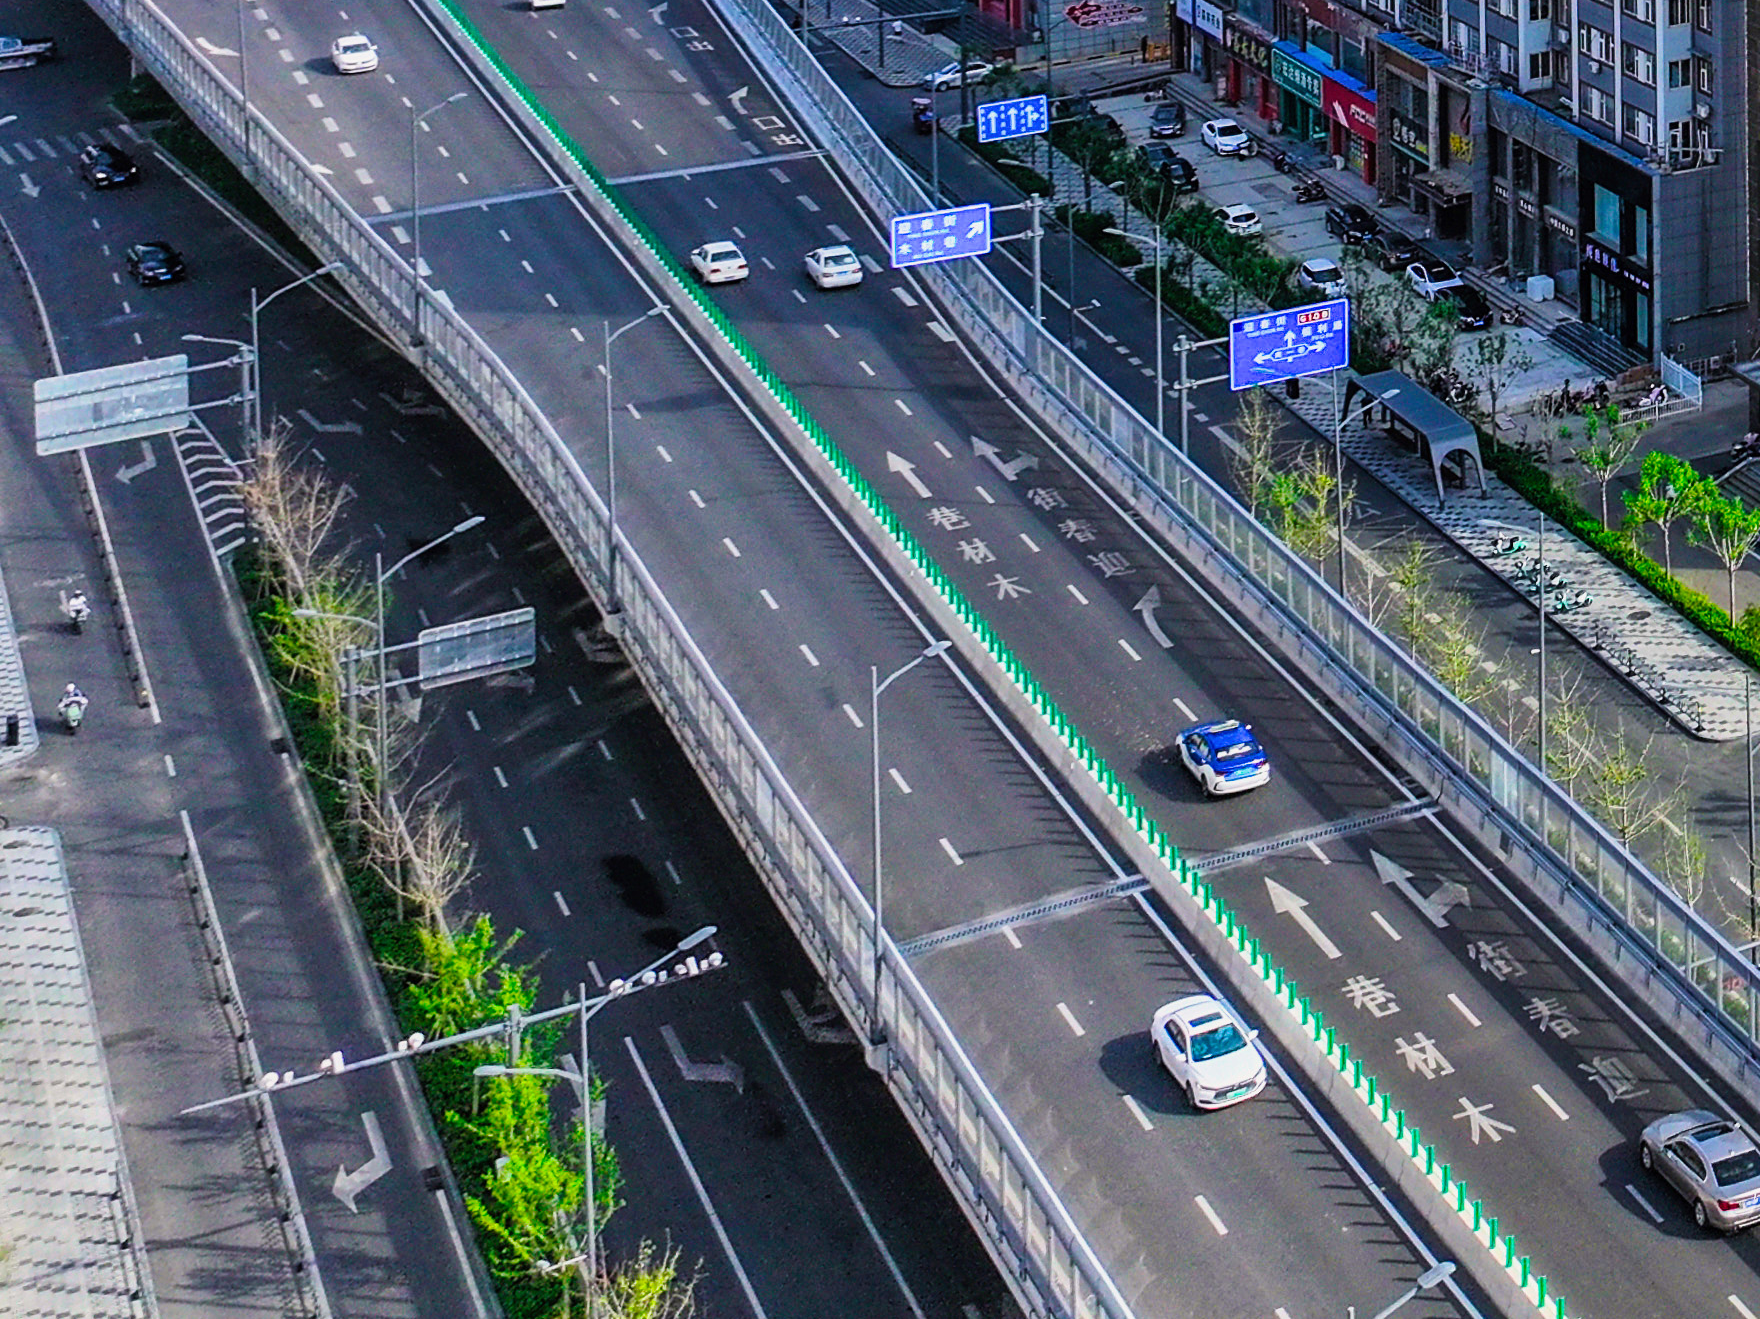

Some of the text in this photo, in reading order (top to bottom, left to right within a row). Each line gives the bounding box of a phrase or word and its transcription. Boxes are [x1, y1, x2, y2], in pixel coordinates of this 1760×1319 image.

[752, 116, 803, 146] 出口
[926, 506, 1032, 601] 木材巷
[1341, 975, 1517, 1145] 木材巷
[1466, 940, 1650, 1103] 迎春街
